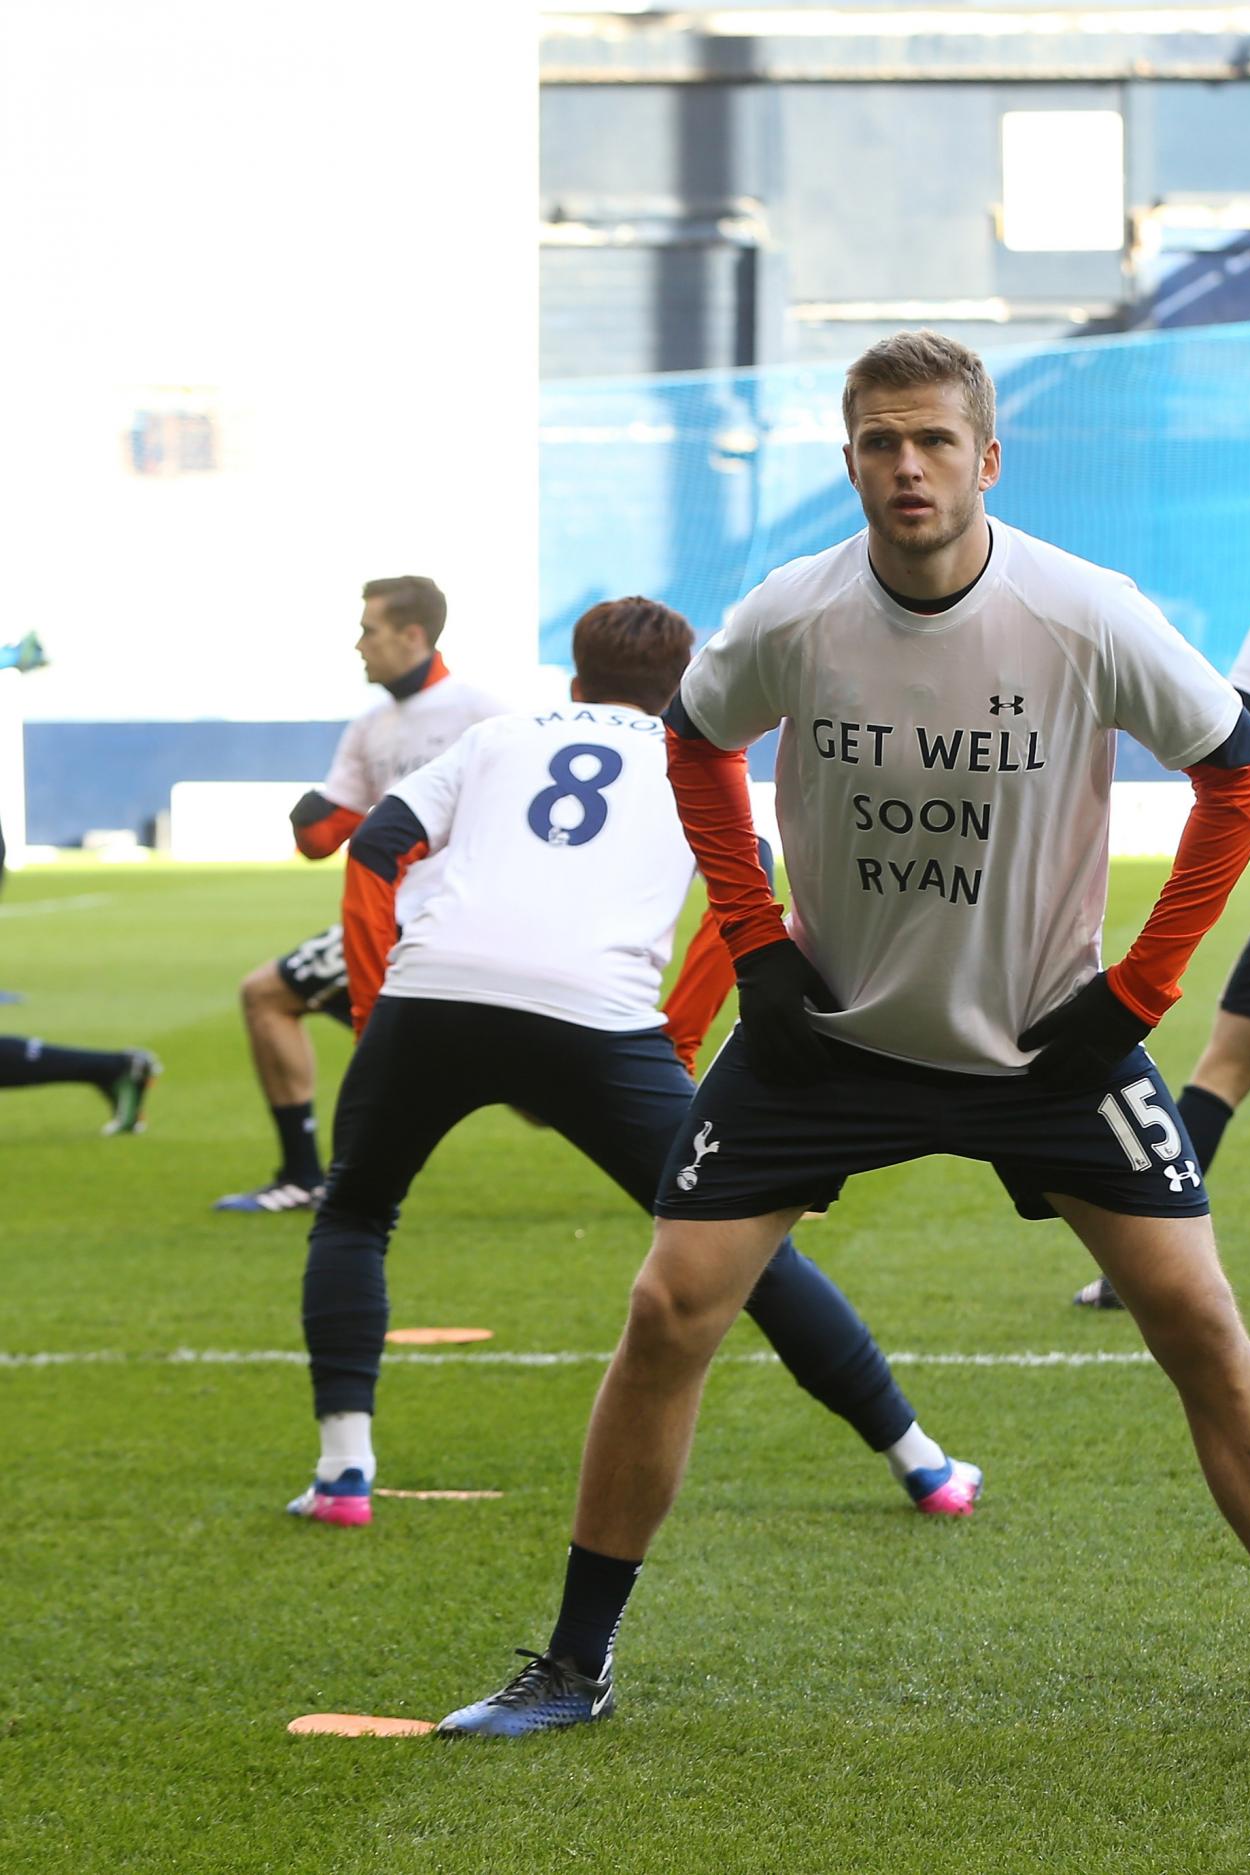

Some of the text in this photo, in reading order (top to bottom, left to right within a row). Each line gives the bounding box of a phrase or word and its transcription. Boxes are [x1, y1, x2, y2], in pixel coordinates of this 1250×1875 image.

[812, 718, 1046, 773] GET WELL
[527, 743, 623, 847] 8
[852, 793, 992, 841] SOON
[856, 857, 983, 906] RYAN
[1097, 1077, 1182, 1172] 15
